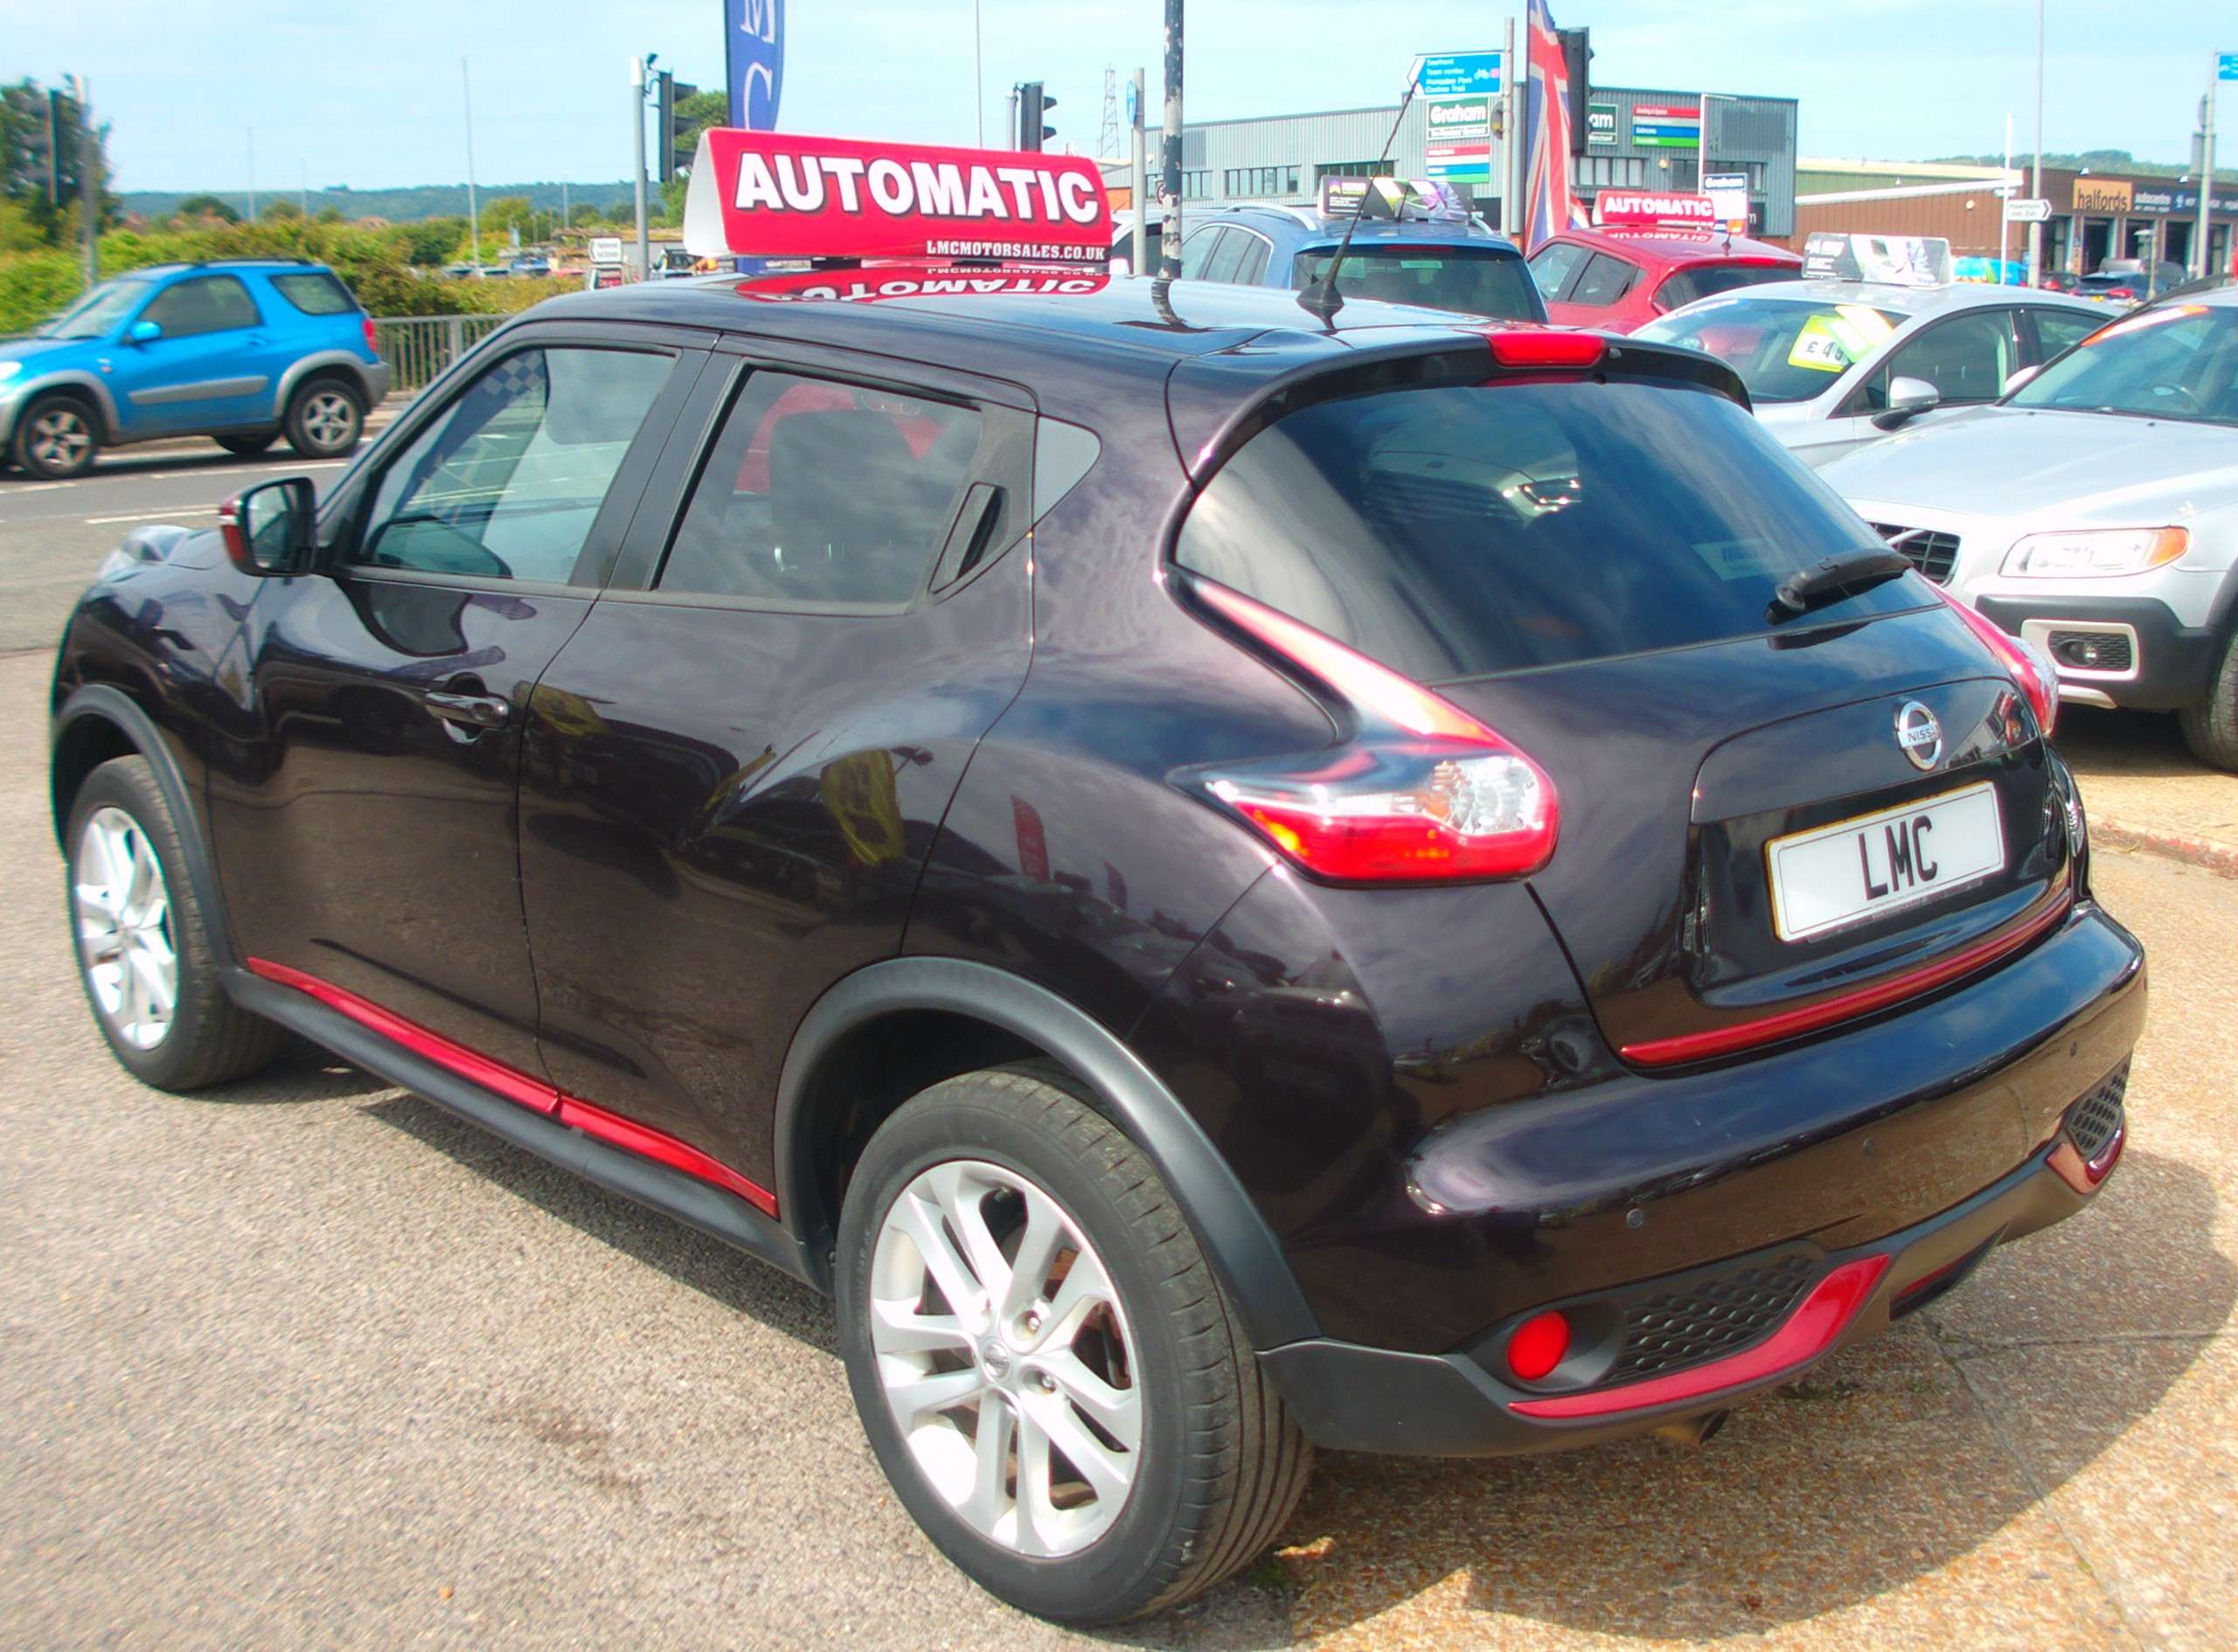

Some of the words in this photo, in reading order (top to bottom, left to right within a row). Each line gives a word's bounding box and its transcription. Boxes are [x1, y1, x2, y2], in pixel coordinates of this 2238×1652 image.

[1430, 104, 1486, 124] Graham
[735, 151, 1100, 223] AUTOMATIC
[1604, 197, 1713, 217] AUTOMATIC
[2078, 189, 2127, 212] halfords
[927, 239, 1105, 261] LMCMOTORSALES.CO.UK
[1858, 815, 1938, 901] LMC
